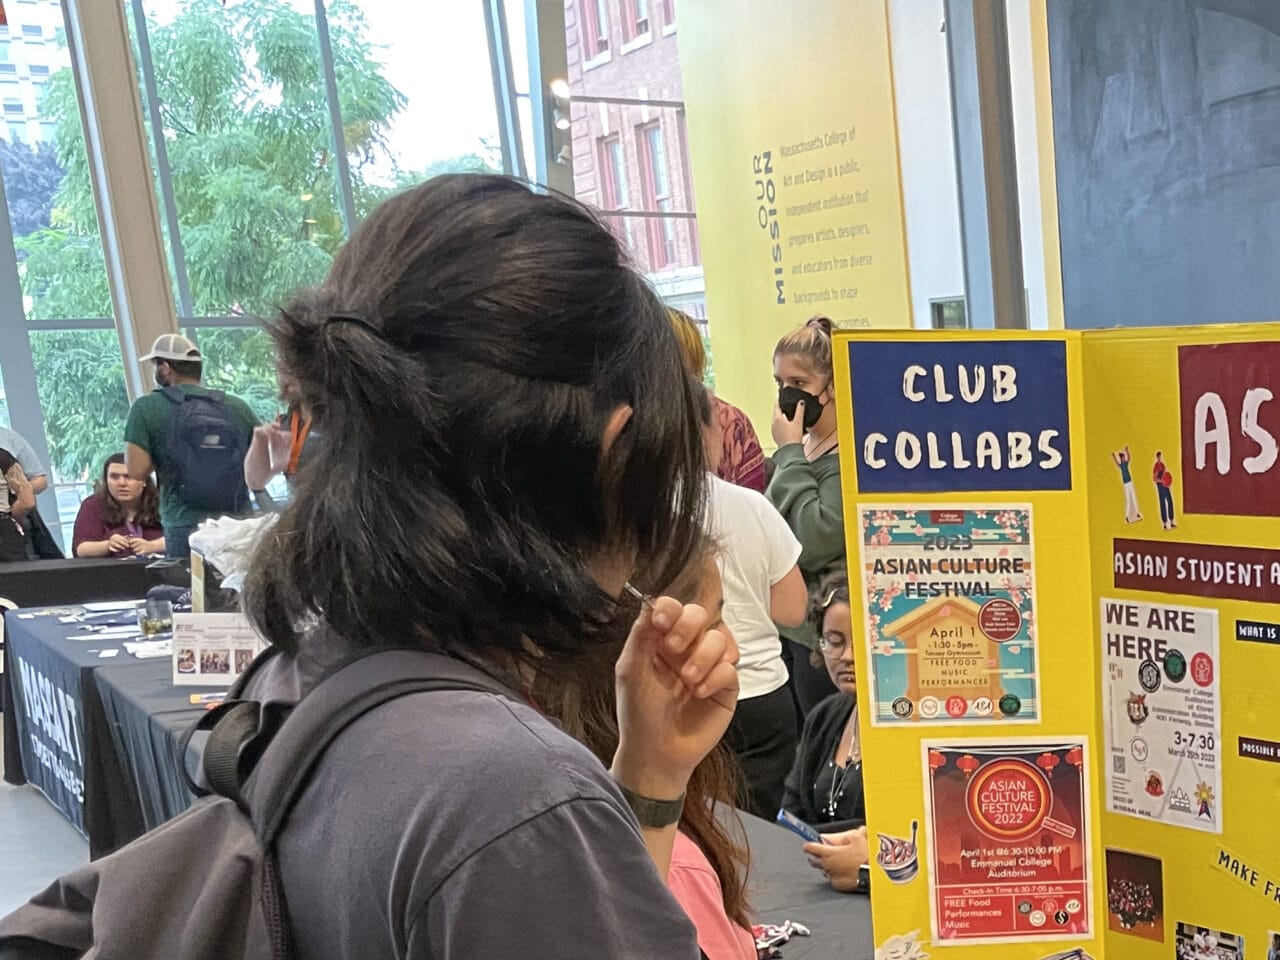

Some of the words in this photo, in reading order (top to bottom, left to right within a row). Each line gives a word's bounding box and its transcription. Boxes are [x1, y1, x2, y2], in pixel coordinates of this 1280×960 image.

[824, 129, 848, 147] College
[849, 126, 857, 140] of
[784, 174, 793, 188] Art
[794, 171, 805, 186] and
[806, 166, 826, 184] Design
[754, 154, 768, 228] OUR
[855, 189, 869, 204] that
[763, 150, 786, 304] MISSION
[792, 263, 802, 276] and
[833, 256, 849, 271] from
[850, 254, 873, 268] diverse
[903, 364, 1018, 404] CLUB
[864, 429, 1062, 471] COLLABS
[923, 534, 974, 551] 2023
[873, 558, 932, 575] ASIAN
[937, 557, 1024, 574] CULTURE
[1114, 552, 1168, 578] ASIAN
[1176, 557, 1264, 588] STUDENT
[904, 581, 997, 598] FESTIVAL
[1106, 603, 1138, 628] WE
[1146, 608, 1196, 634] ARE
[930, 626, 963, 640] April
[971, 626, 976, 638] 1
[1239, 626, 1264, 638] WHAT
[1267, 628, 1277, 640] IS
[957, 640, 974, 650] 5pm
[1107, 634, 1168, 663] HERE
[942, 668, 968, 676] MUSIC
[922, 678, 988, 686] PERFORMANCES
[1242, 742, 1275, 757] POSSIBLE
[989, 780, 1026, 792] ASIAN
[981, 791, 1035, 802] CULTURE
[982, 802, 1036, 814] FESTIVAL
[994, 814, 1024, 825] 2022
[960, 848, 980, 858] April
[982, 848, 994, 856] 1st
[1048, 846, 1062, 854] PM
[971, 858, 1016, 868] Emmanuel
[1018, 858, 1052, 868] College
[1219, 850, 1258, 888] MAKE
[988, 869, 1036, 878] Auditorium
[944, 898, 966, 908] FREE
[968, 898, 990, 906] Food
[945, 908, 1002, 918] Performances
[946, 920, 970, 928] Music
